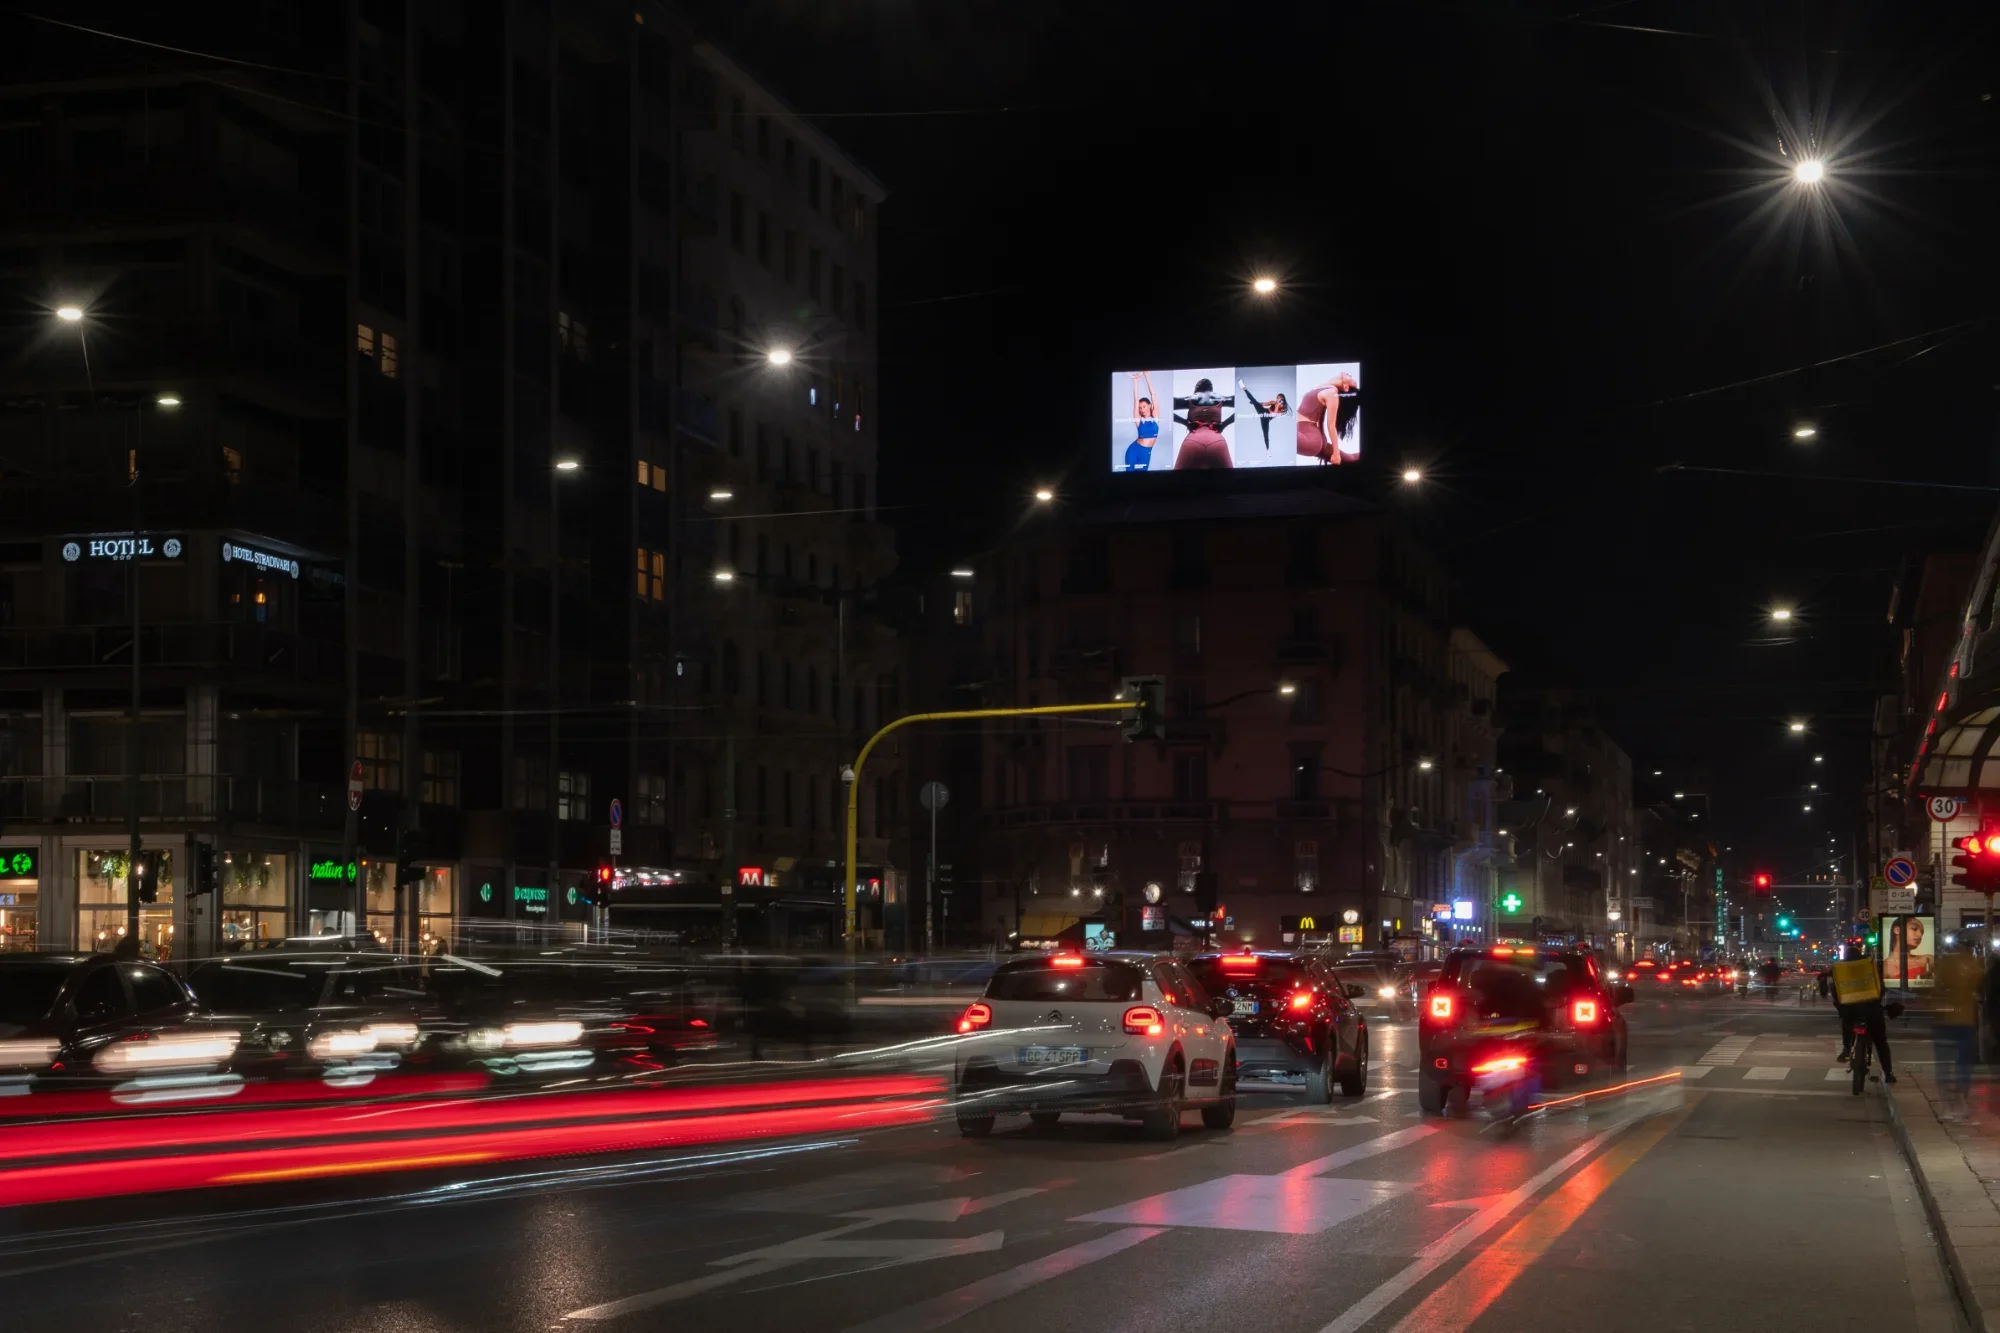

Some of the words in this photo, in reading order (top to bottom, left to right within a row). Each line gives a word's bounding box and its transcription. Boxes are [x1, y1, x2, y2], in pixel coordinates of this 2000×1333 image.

[90, 538, 154, 557] HOTEL
[232, 545, 253, 562] HOTEL
[1935, 799, 1953, 813] 30
